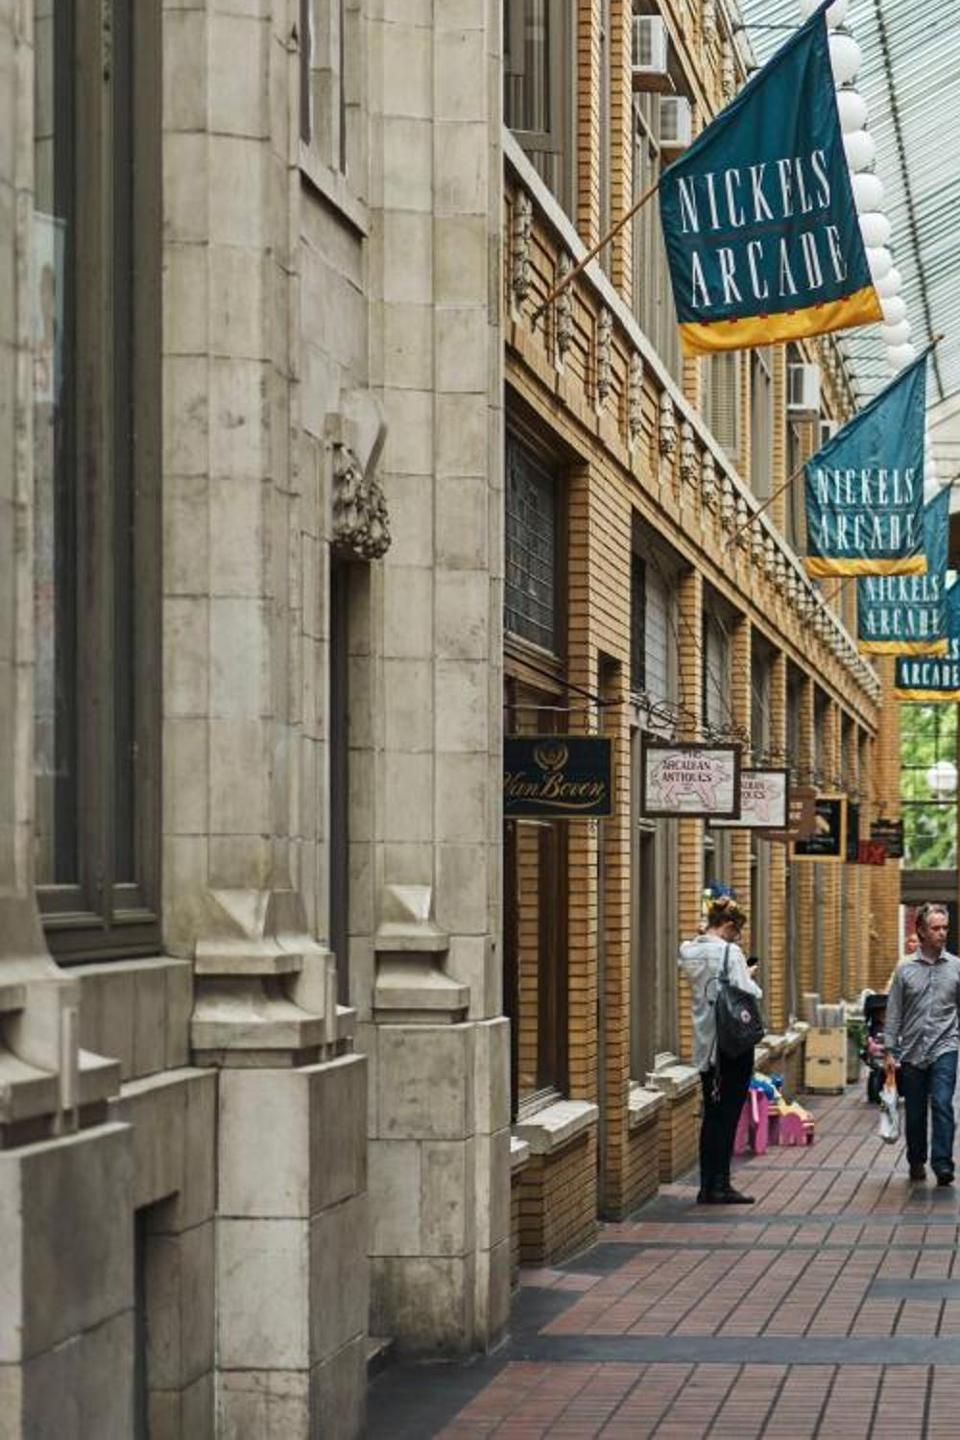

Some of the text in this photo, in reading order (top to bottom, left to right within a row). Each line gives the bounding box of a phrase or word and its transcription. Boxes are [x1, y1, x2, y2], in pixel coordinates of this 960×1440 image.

[676, 150, 831, 234] NICKELS
[690, 225, 848, 308] ARCADE
[816, 468, 915, 504] NICKELS
[816, 513, 915, 550] ARCADE
[865, 575, 940, 602] NICKELS
[867, 608, 940, 635] ARCADE
[902, 662, 959, 687] ARCADE
[662, 760, 712, 771] ARCADIAN
[662, 771, 713, 783] ANTIQUES
